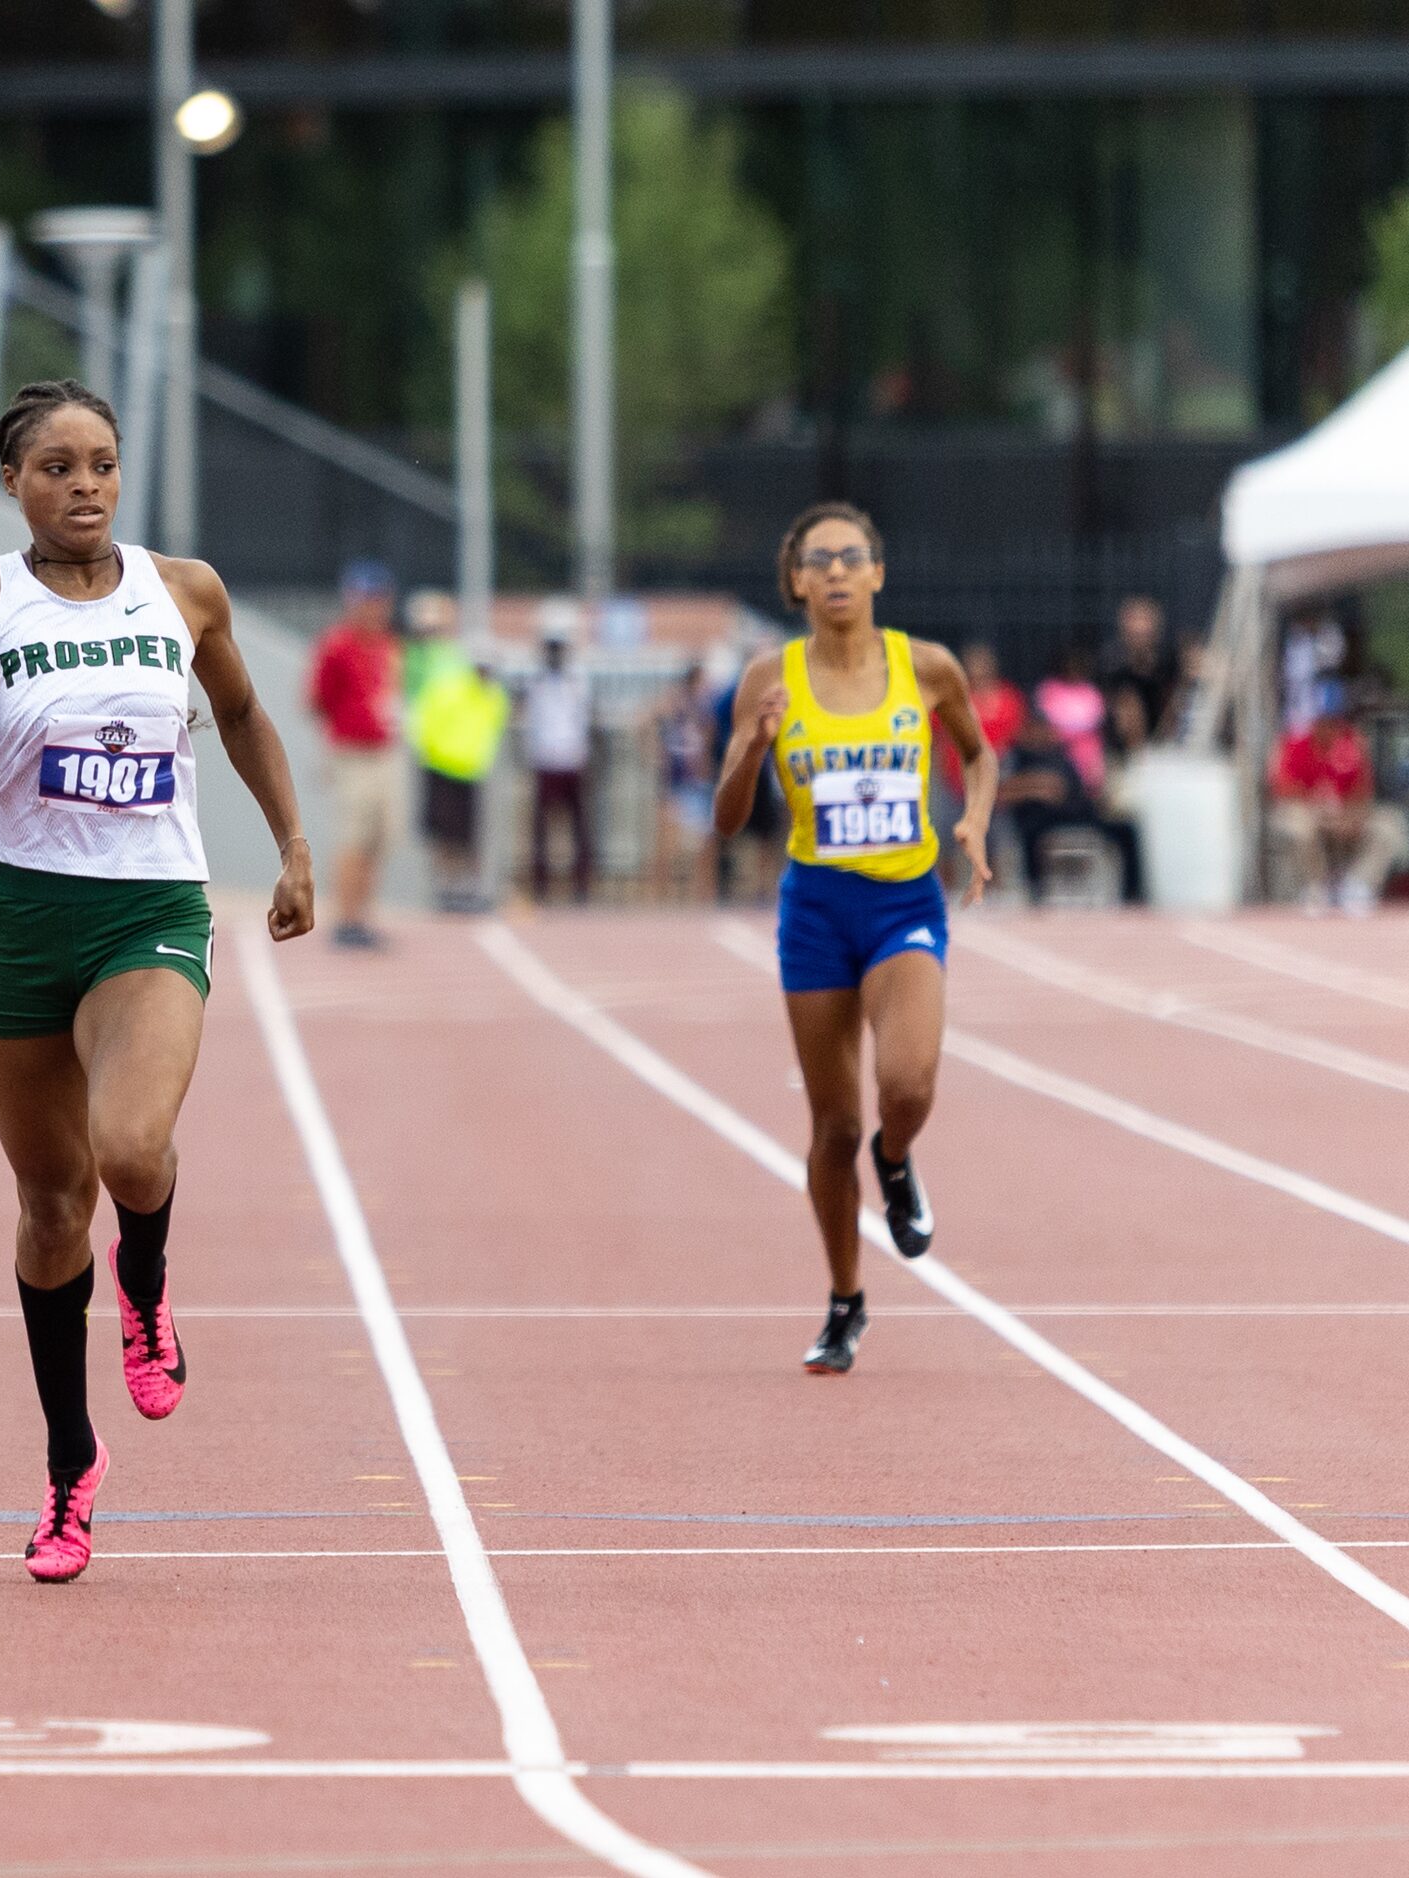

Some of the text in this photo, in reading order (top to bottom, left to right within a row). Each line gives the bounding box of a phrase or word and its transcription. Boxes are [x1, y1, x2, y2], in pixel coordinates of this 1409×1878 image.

[95, 730, 136, 743] STATE
[58, 754, 161, 804] 1907
[824, 802, 914, 845] 1964
